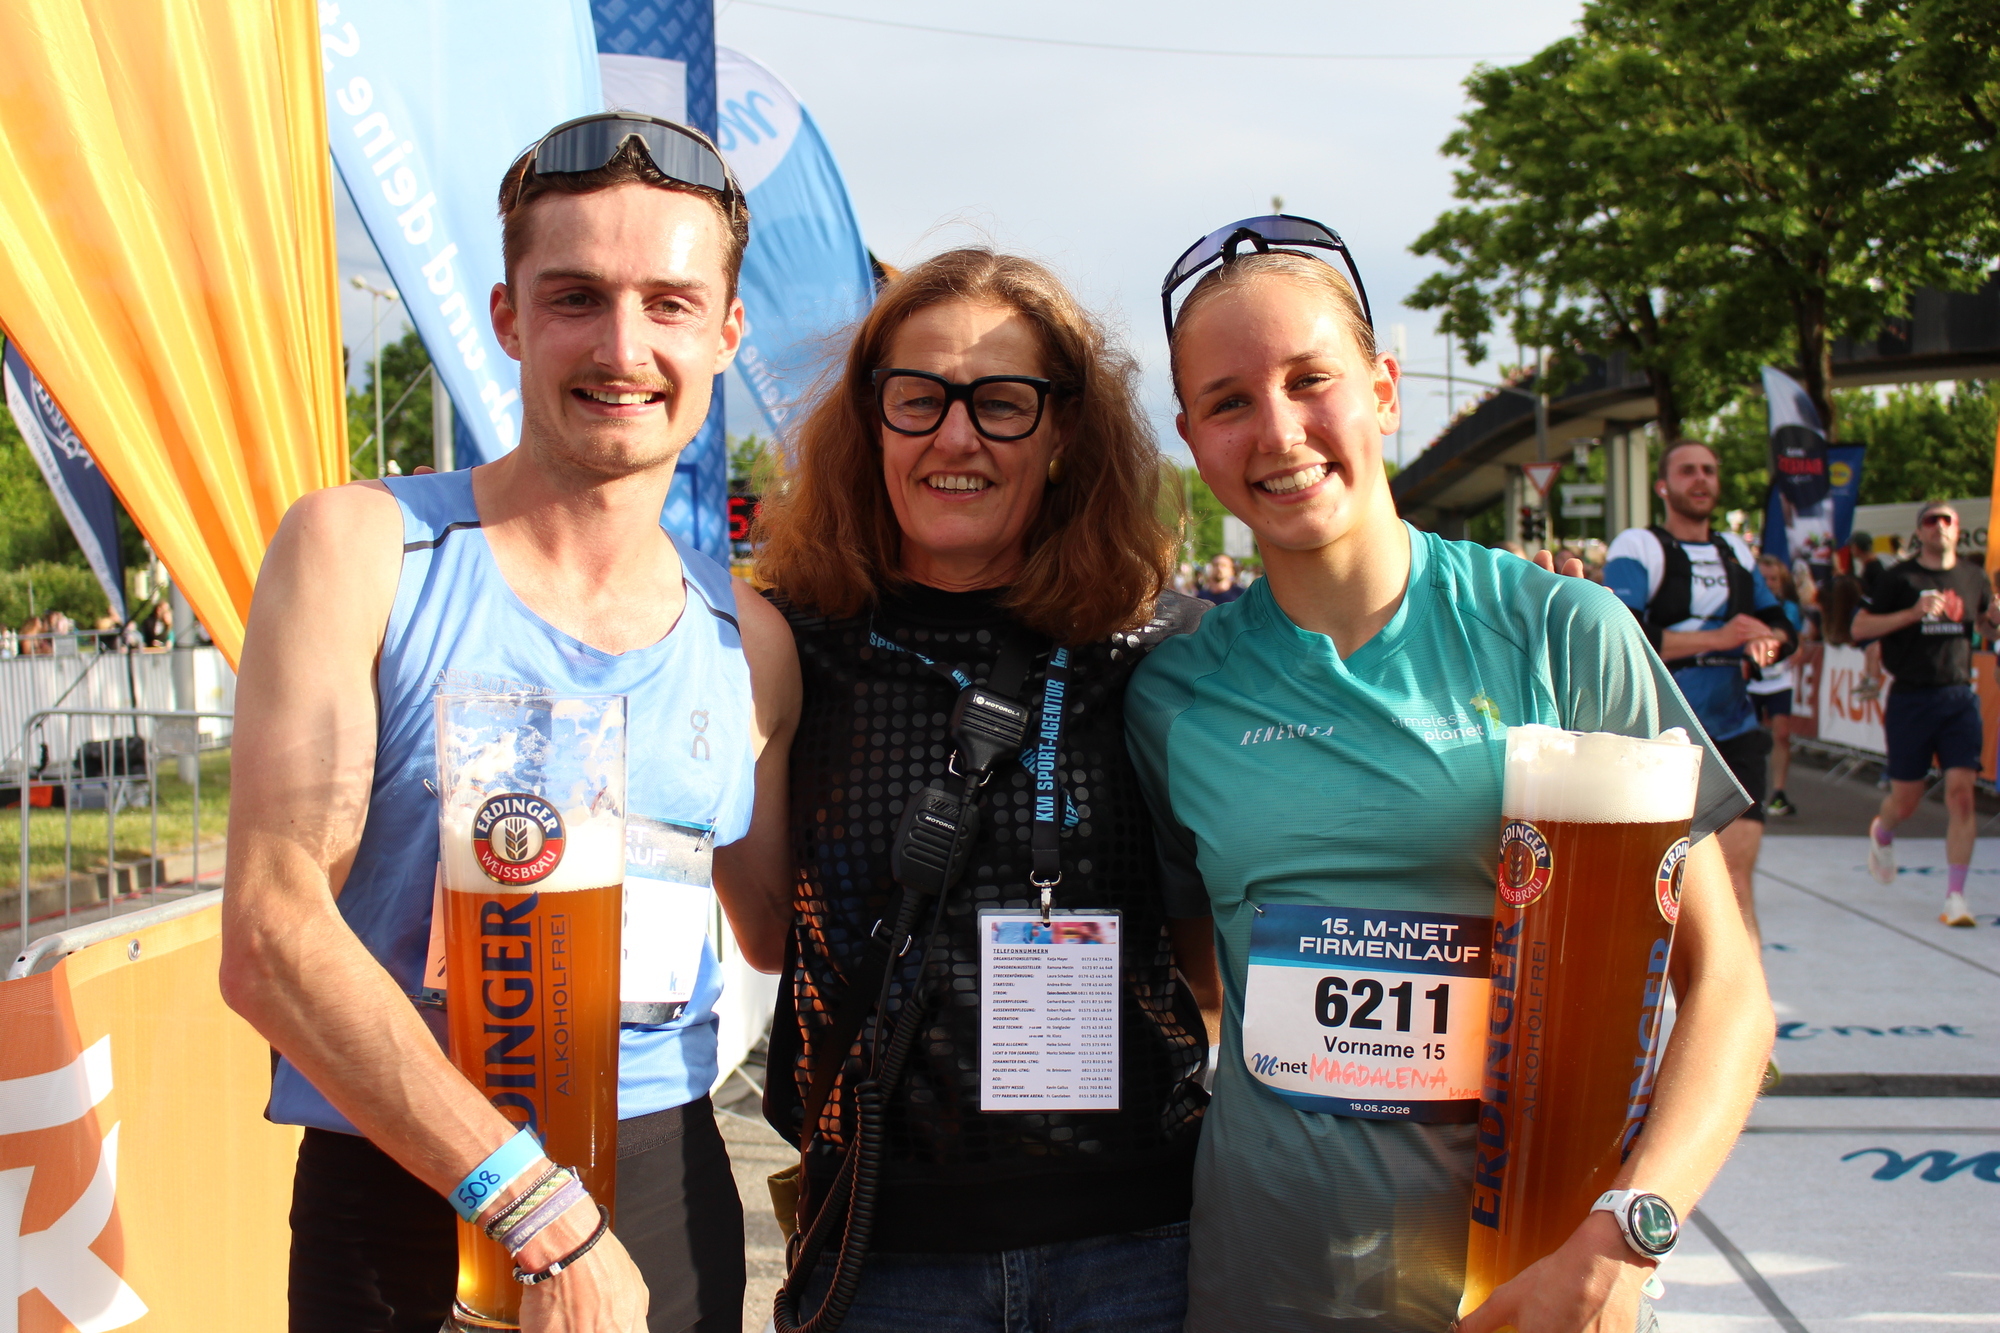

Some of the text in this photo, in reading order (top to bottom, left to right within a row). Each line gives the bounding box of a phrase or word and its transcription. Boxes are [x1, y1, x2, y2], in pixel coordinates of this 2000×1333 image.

[984, 701, 1020, 717] MOTOROLA
[1391, 712, 1469, 729] timeless
[1036, 678, 1065, 791] SPORT-AGENTUR
[1423, 723, 1485, 743] planet
[476, 799, 558, 833] ERDINGER
[925, 815, 957, 831] MOTOROL
[481, 850, 557, 879] WEISSBRÄU
[1321, 917, 1459, 942] 15. M-NET
[1299, 936, 1481, 963] FIRMENLAUF
[550, 913, 571, 1097] ALKOHOLFREI
[1314, 976, 1450, 1035] 6211
[1522, 940, 1547, 1122] ALKOHOLFREI
[1323, 1035, 1446, 1060] Vorname 15
[1309, 1053, 1448, 1090] MAGDALENA
[1349, 1103, 1410, 1115] 19.05.2026
[458, 1170, 501, 1209] 508
